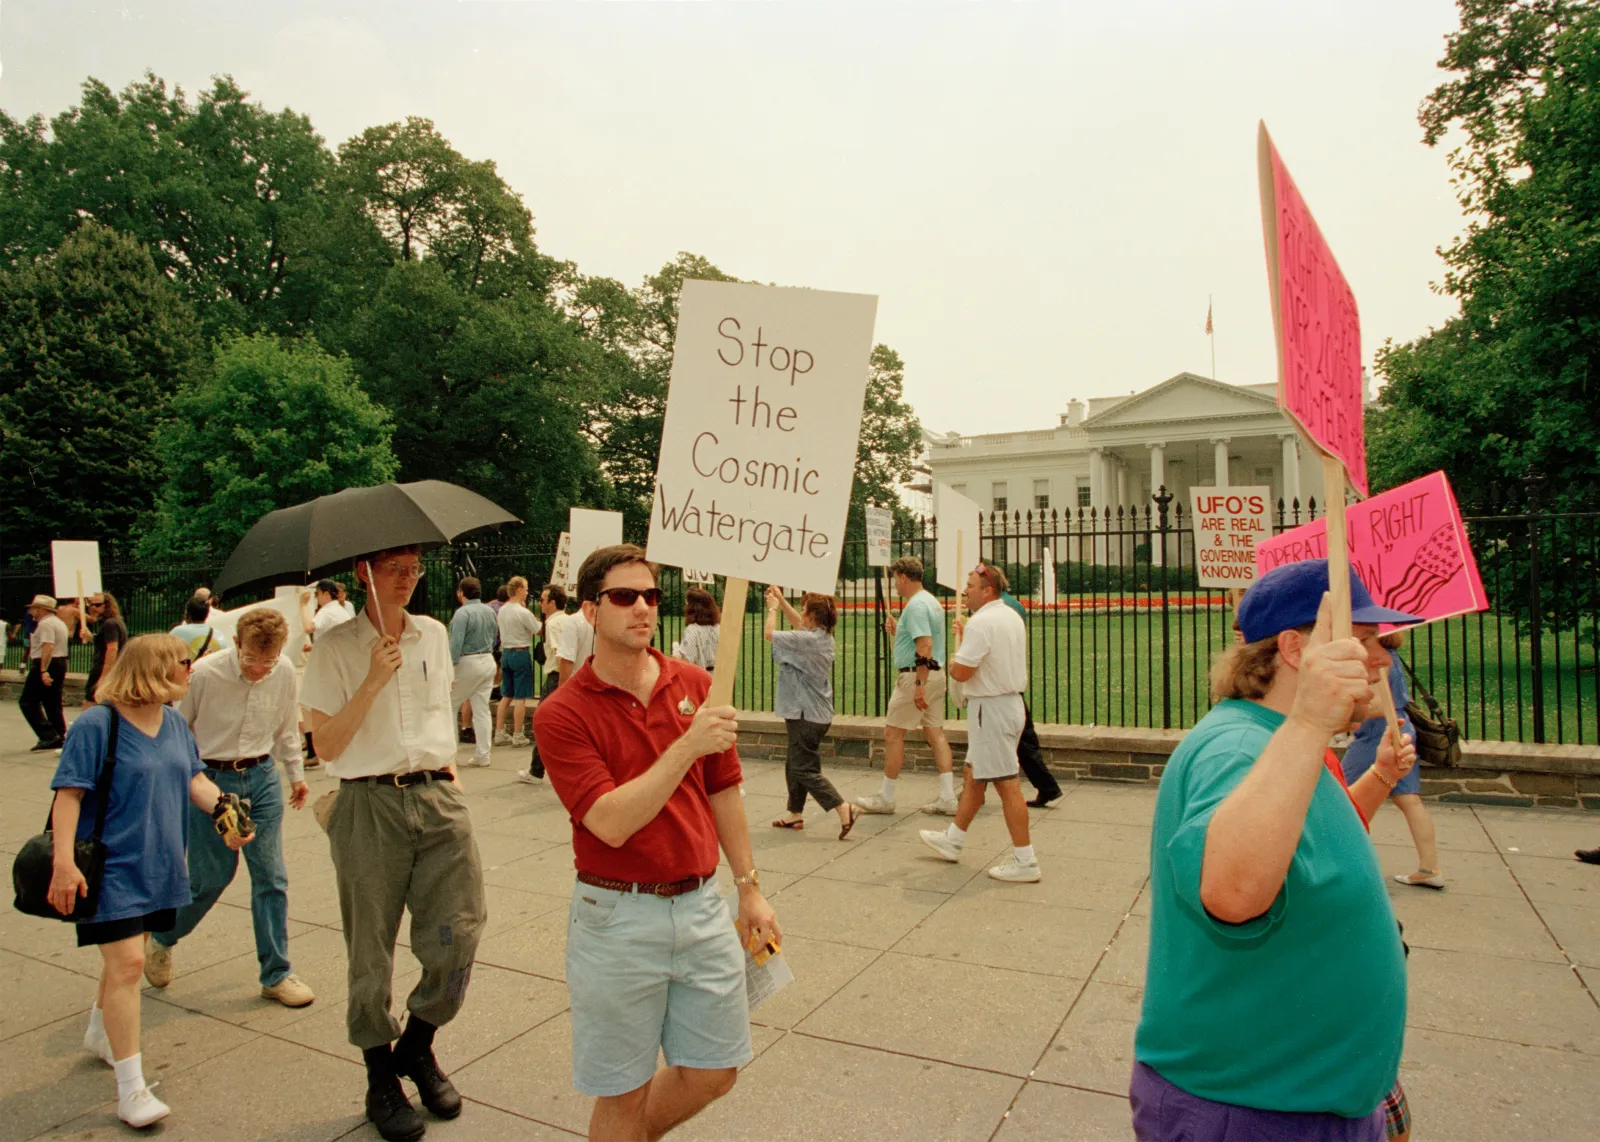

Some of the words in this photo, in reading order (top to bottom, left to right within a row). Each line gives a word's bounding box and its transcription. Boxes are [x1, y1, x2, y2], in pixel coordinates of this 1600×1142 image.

[717, 317, 815, 386] Stop
[728, 384, 798, 432] the
[692, 431, 820, 495] Cosmic
[1196, 496, 1264, 514] UFO'S
[659, 483, 829, 562] Watergate
[1201, 517, 1226, 531] ARE
[1231, 518, 1265, 532] REAL
[1259, 520, 1355, 571] “OPERATN
[1369, 492, 1430, 547] RIGHT
[1200, 549, 1256, 564] GOVERNME
[1214, 533, 1223, 547] &
[1228, 534, 1254, 548] THE
[1201, 565, 1253, 580] KNOWS
